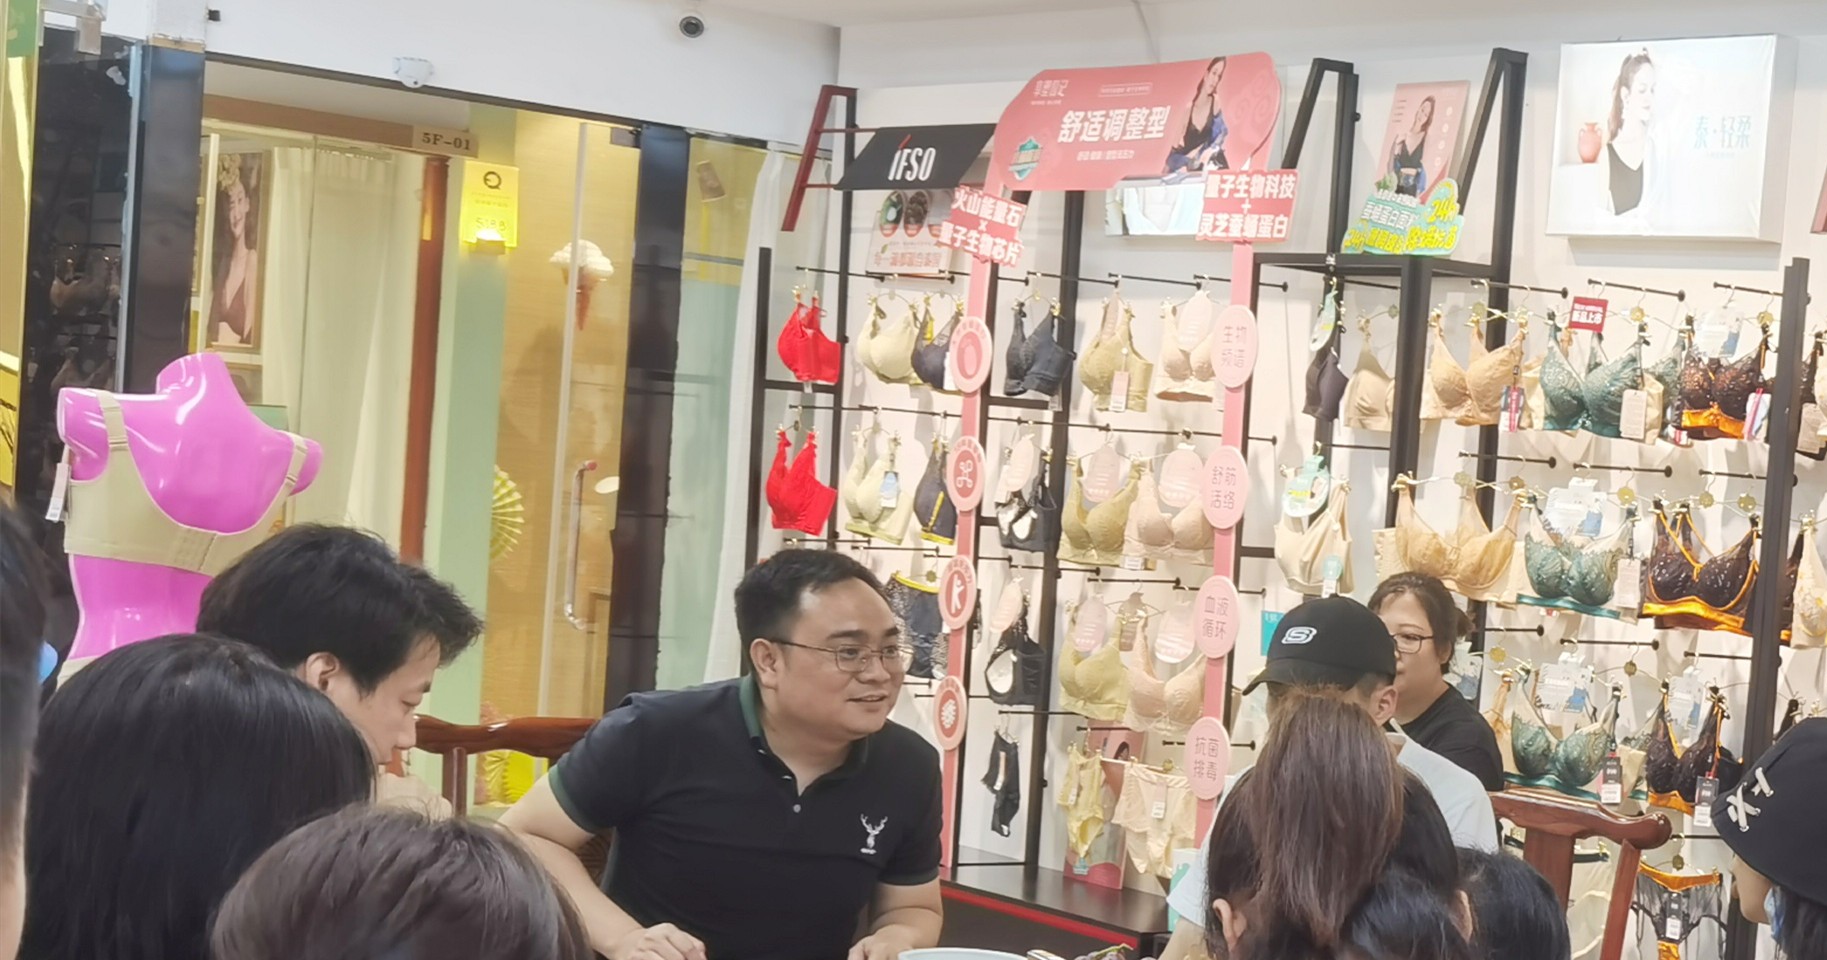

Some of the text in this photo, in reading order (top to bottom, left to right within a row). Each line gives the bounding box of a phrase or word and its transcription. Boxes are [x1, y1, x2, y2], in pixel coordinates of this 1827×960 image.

[1057, 105, 1171, 143] 舒适调整型
[422, 132, 471, 150] 5F-01
[1205, 174, 1297, 199] 量子生物科技
[951, 189, 1023, 228] 火山能量石
[1198, 212, 1289, 239] 灵芝蚕蛹蛋白
[938, 220, 1023, 267] 量子生物芯片
[1212, 466, 1237, 486] 舒筋
[1210, 489, 1236, 510] 活络
[1204, 595, 1229, 617] 血液
[1202, 618, 1227, 640] 循环
